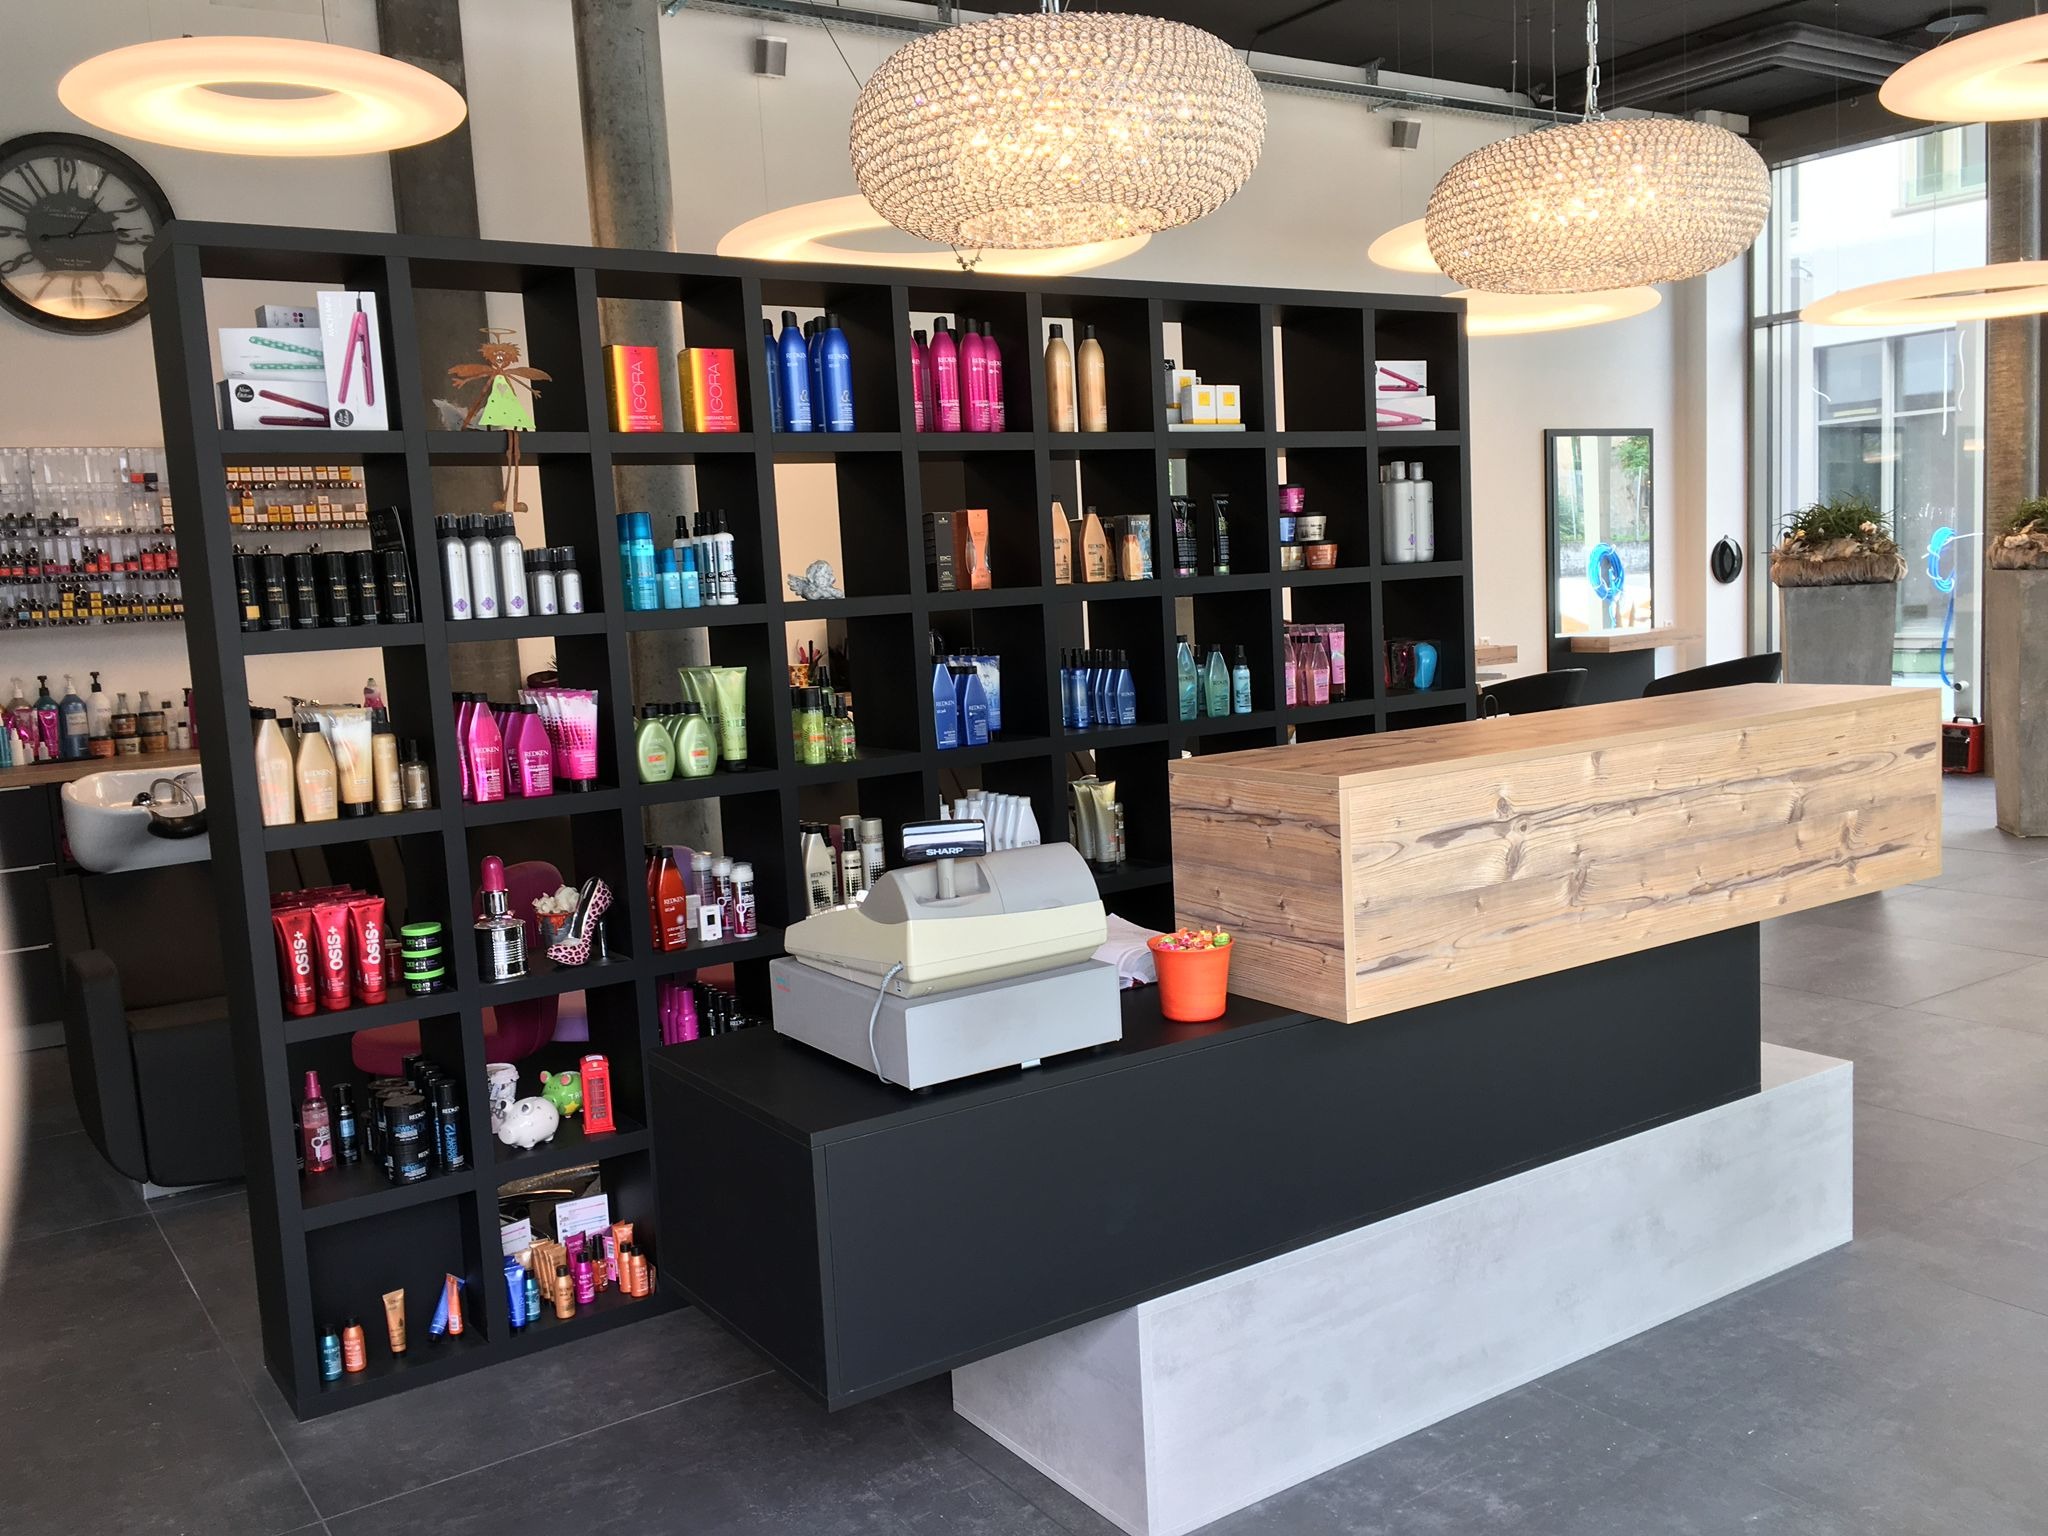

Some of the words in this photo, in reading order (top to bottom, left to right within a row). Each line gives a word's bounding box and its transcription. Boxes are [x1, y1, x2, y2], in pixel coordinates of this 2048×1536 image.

[15, 162, 50, 201] 11
[54, 156, 78, 194] 12
[71, 277, 86, 310] 6
[631, 361, 648, 413] IGORA
[708, 363, 724, 414] IGORA
[474, 746, 500, 755] REDKEN
[926, 847, 964, 856] SHARP
[663, 895, 685, 905] REDKEN
